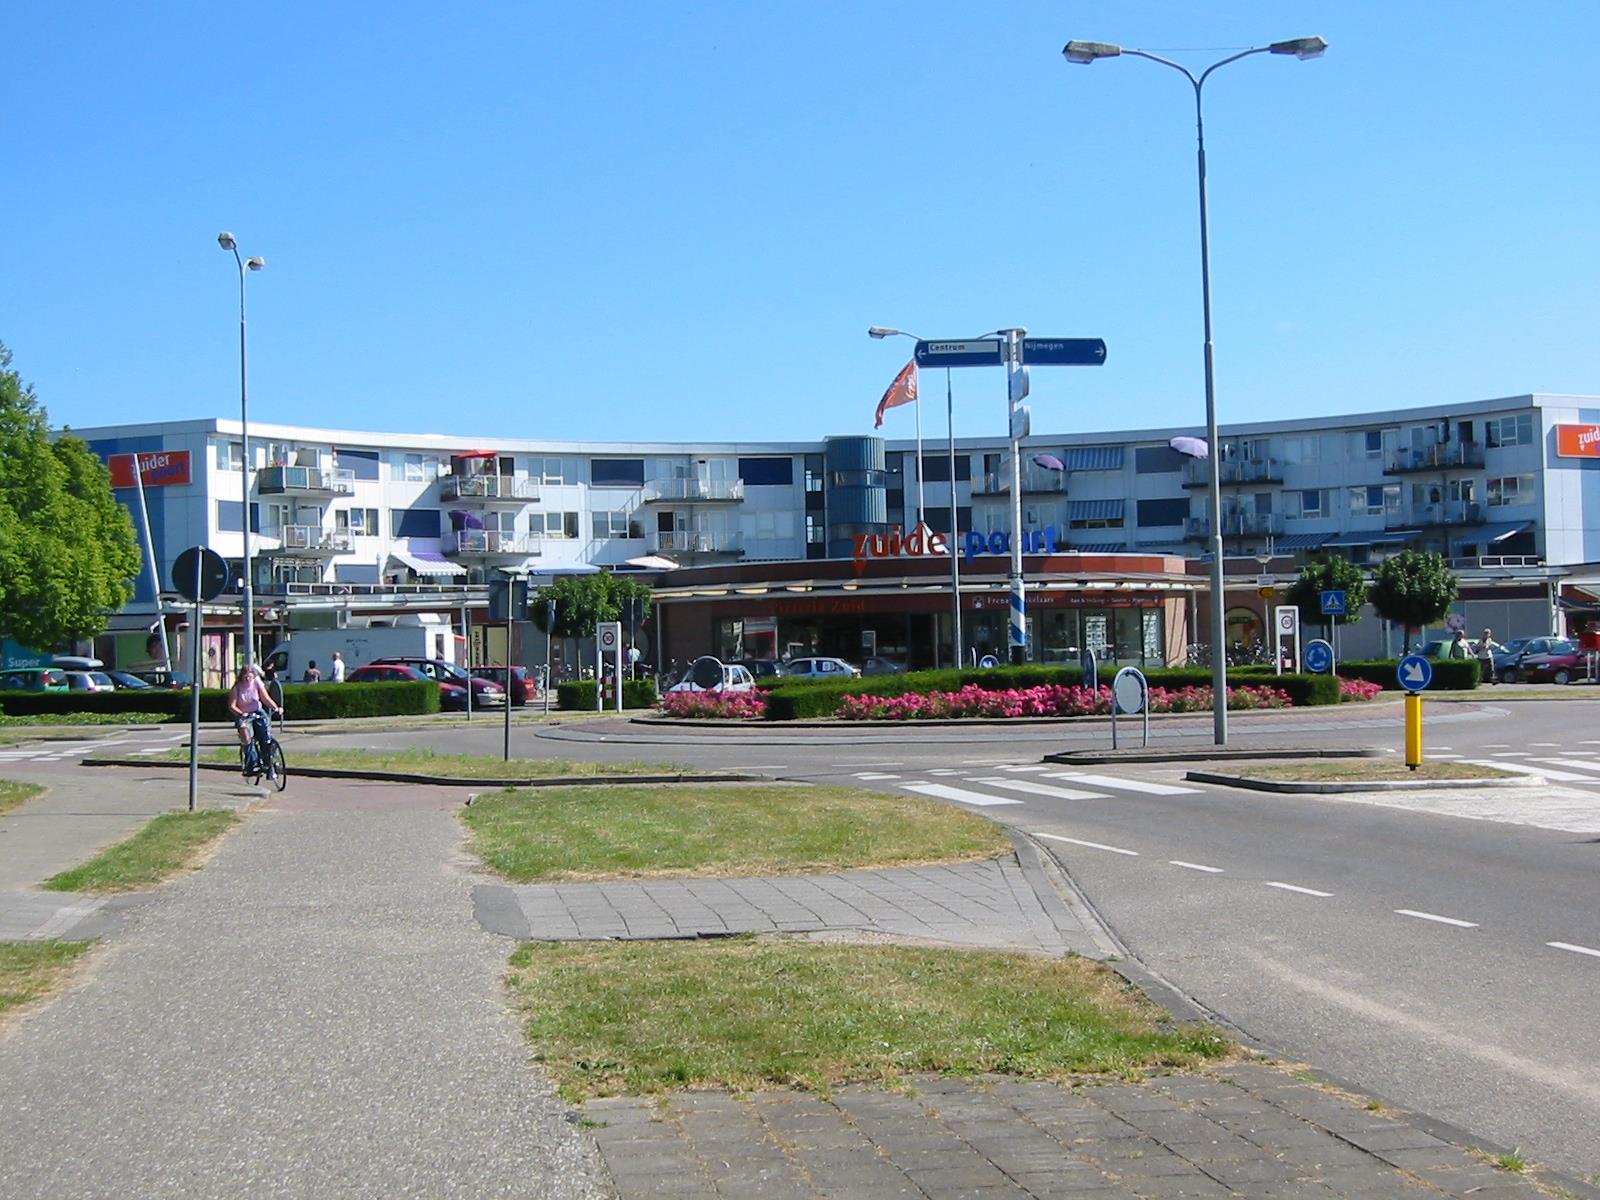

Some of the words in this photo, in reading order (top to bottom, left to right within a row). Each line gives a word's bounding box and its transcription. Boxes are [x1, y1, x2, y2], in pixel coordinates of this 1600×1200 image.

[929, 343, 966, 351] Centrum
[1025, 342, 1065, 351] Nijmegen
[8, 656, 41, 668] Super
